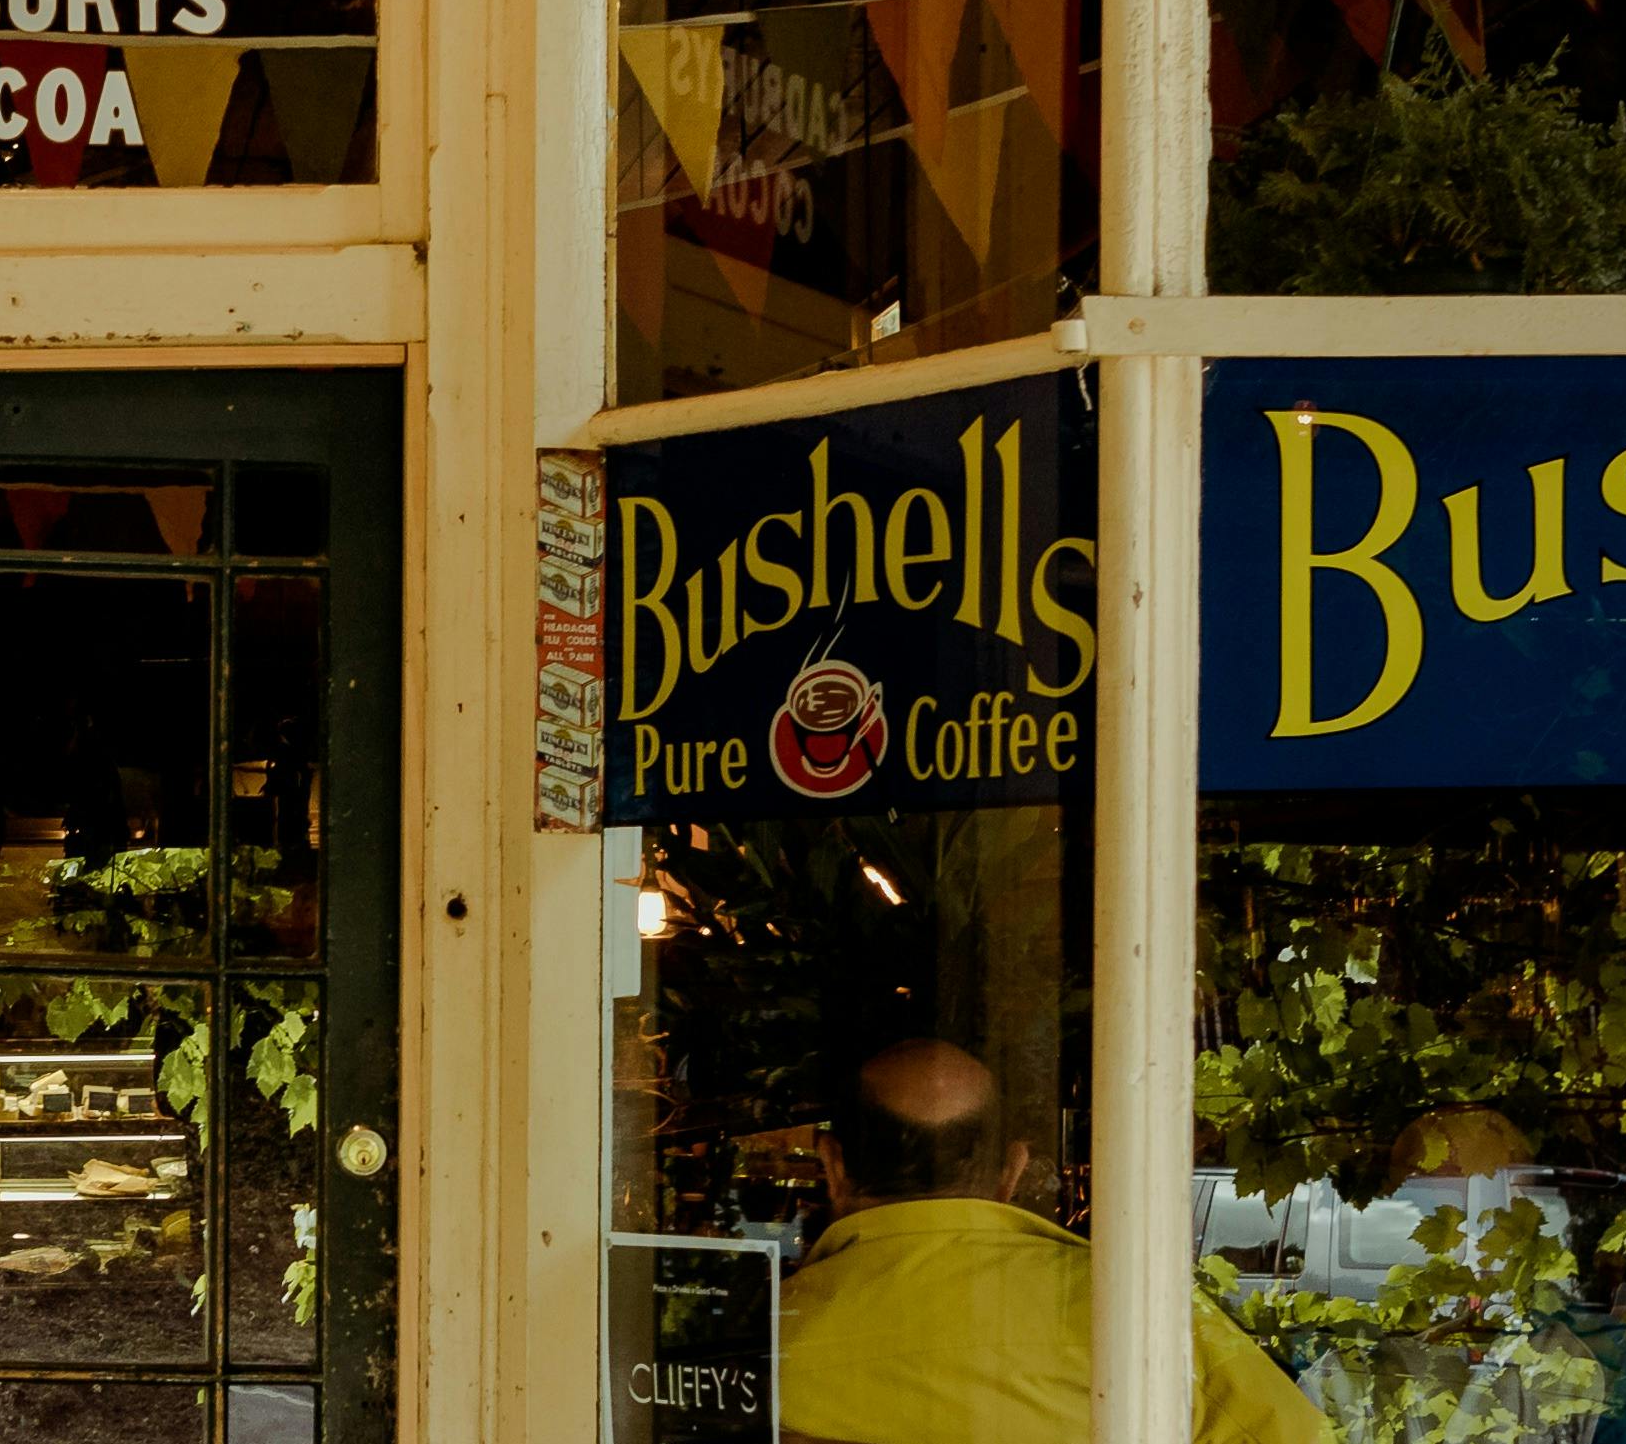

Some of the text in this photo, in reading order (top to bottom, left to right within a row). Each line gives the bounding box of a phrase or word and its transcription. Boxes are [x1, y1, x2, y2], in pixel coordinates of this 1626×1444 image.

[617, 414, 1096, 722] Bushells
[634, 691, 1078, 797] Pure Coffee
[628, 1362, 757, 1413] CLIFFY'S
